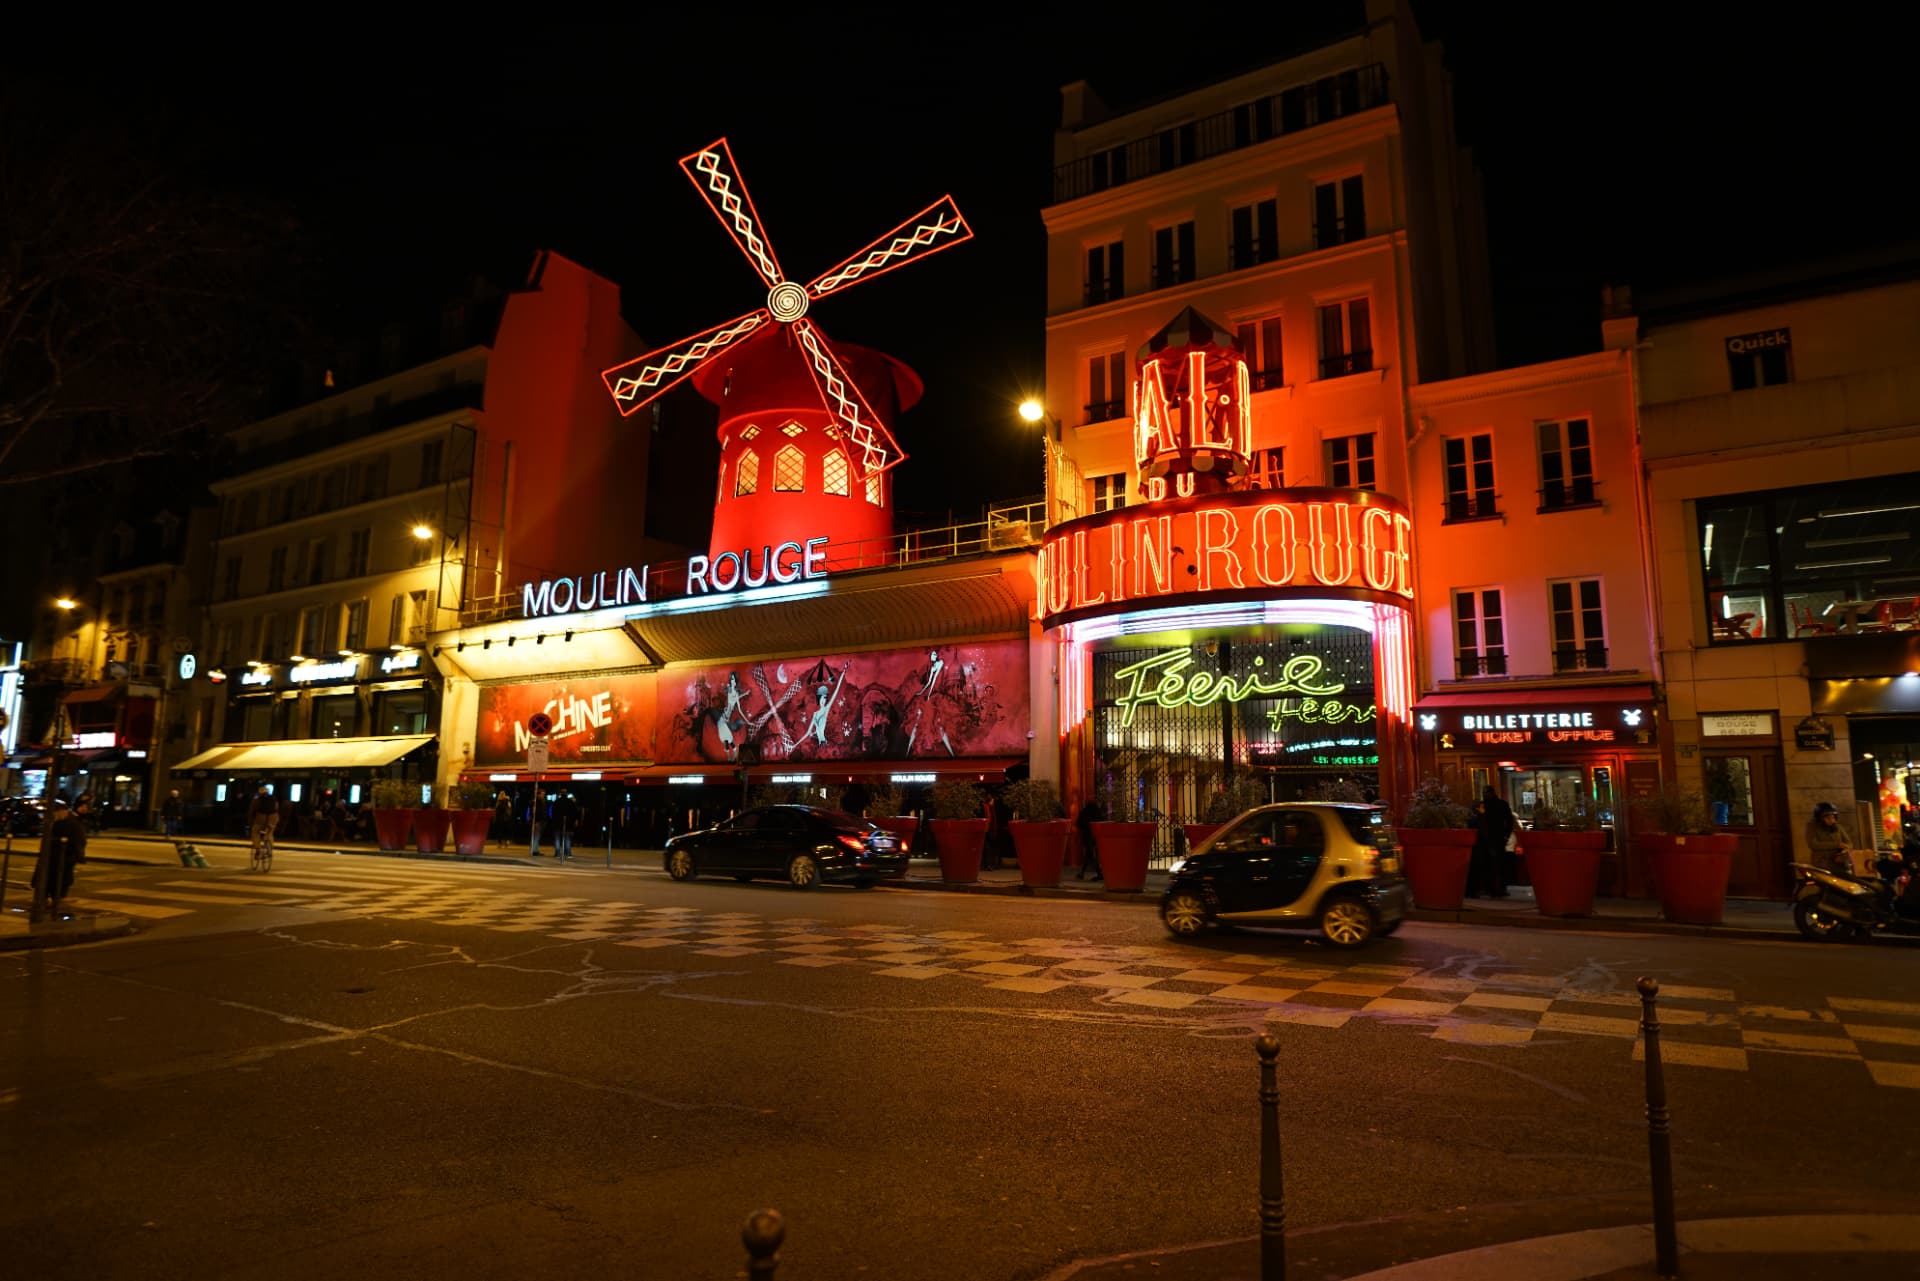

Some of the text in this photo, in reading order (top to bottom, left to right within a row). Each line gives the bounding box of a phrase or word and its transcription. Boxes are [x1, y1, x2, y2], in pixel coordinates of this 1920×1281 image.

[1729, 331, 1788, 353] Quick
[1150, 472, 1195, 501] DU
[523, 536, 829, 617] MOULIN ROUGE
[1195, 503, 1414, 599] ROUGE
[1115, 647, 1345, 728] Féerie
[514, 690, 612, 752] MCHINE
[1463, 712, 1593, 730] BILLETTERIE
